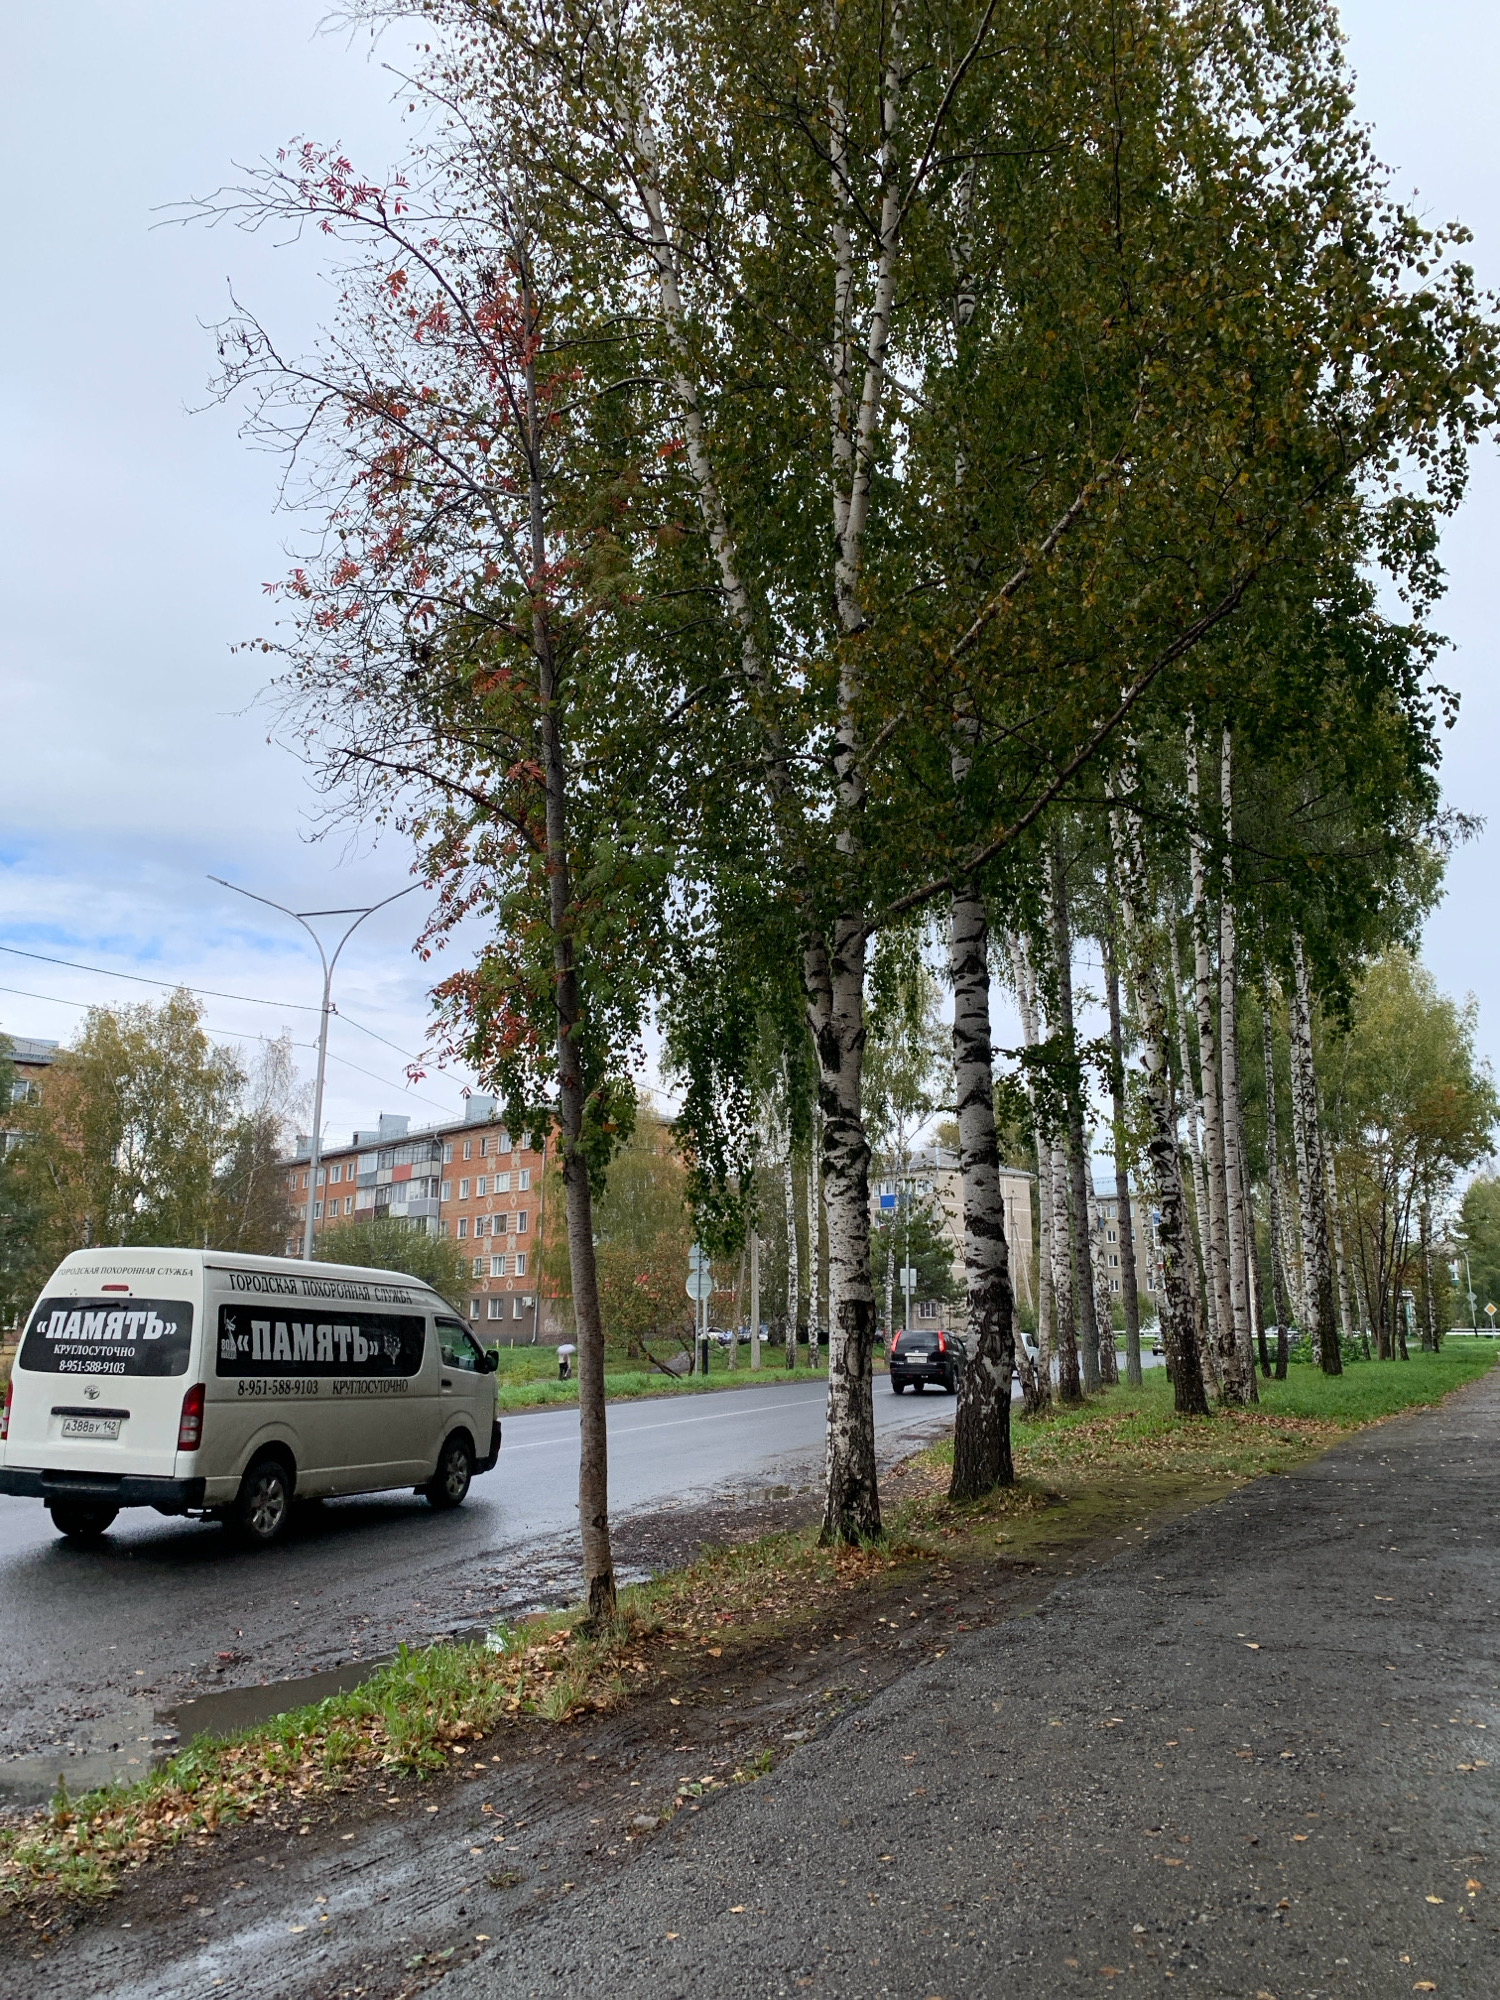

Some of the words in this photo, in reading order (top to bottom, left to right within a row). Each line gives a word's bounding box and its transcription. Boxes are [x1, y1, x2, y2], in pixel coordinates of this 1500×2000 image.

[58, 1267, 99, 1276] ГОРОДСКАЯ
[101, 1267, 155, 1275] ПОХОРОННАЯ
[157, 1268, 193, 1276] СЛУЖБА
[229, 1274, 298, 1295] ГОРОДСКАЯ
[302, 1280, 370, 1300] ПОХОРОННАЯ
[374, 1287, 413, 1304] СЛУЖБА
[36, 1311, 177, 1340] «ПАМЯТЬ»
[237, 1320, 379, 1362] «ПАМЯТЬ»
[54, 1344, 135, 1356] КРУГЛОСУТОЧНО
[59, 1360, 125, 1373] 8-951-588-9103
[237, 1380, 319, 1396] 8-951-588-9103
[332, 1379, 408, 1395] КРУГЛОСУТОЧНО
